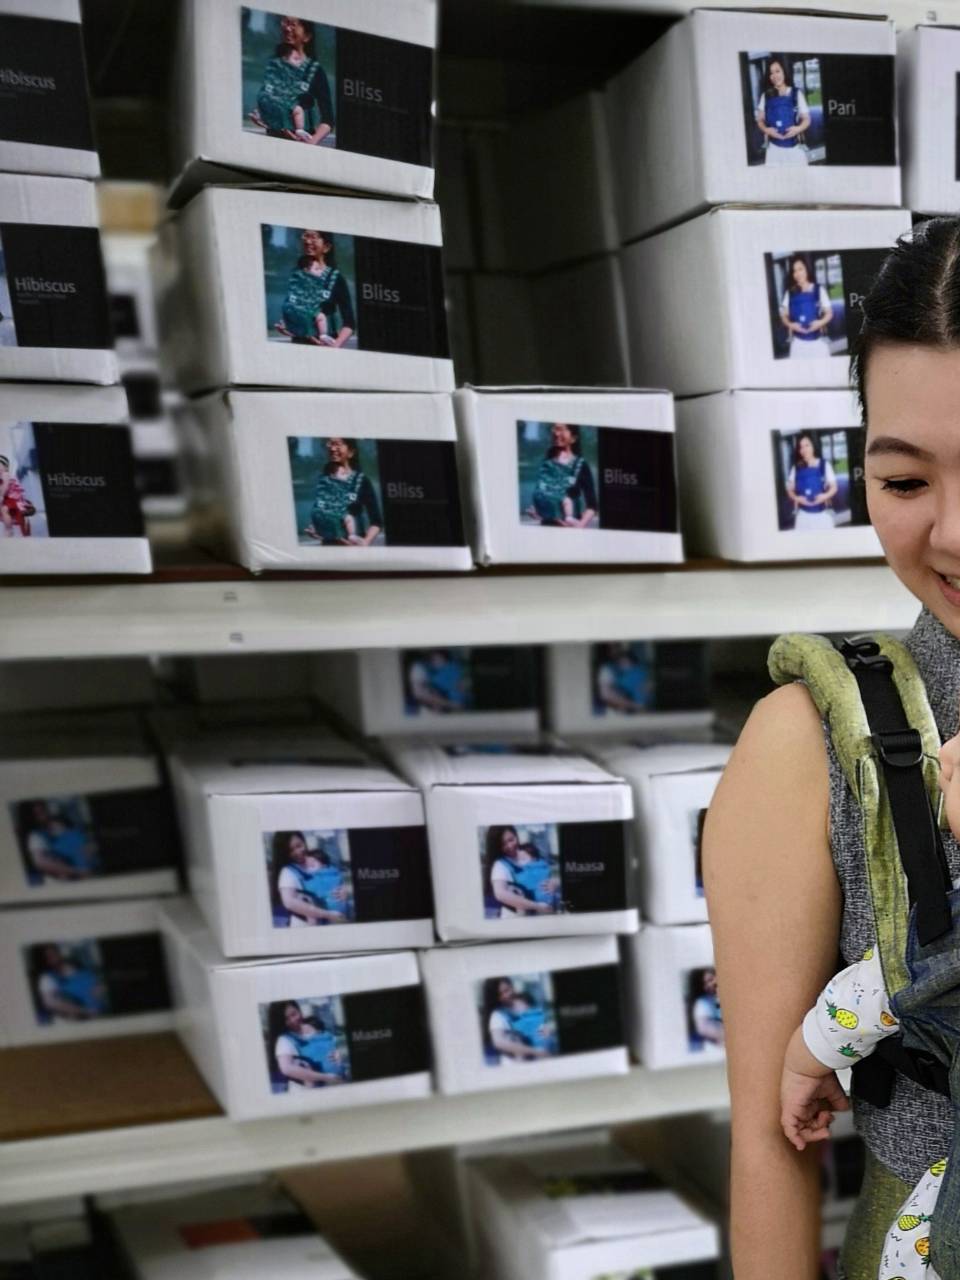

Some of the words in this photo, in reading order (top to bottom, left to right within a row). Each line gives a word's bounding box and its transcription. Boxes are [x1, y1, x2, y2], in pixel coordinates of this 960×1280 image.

[343, 78, 383, 102] Bliss
[828, 98, 856, 116] Pari
[15, 276, 76, 293] Hibiscus
[362, 283, 400, 303] Bliss
[48, 473, 106, 487] Hibiscus
[604, 469, 638, 485] Bliss
[387, 481, 424, 499] Bliss
[357, 867, 400, 880] Maasa
[565, 861, 605, 873] Maasa
[352, 1028, 392, 1042] Maasa
